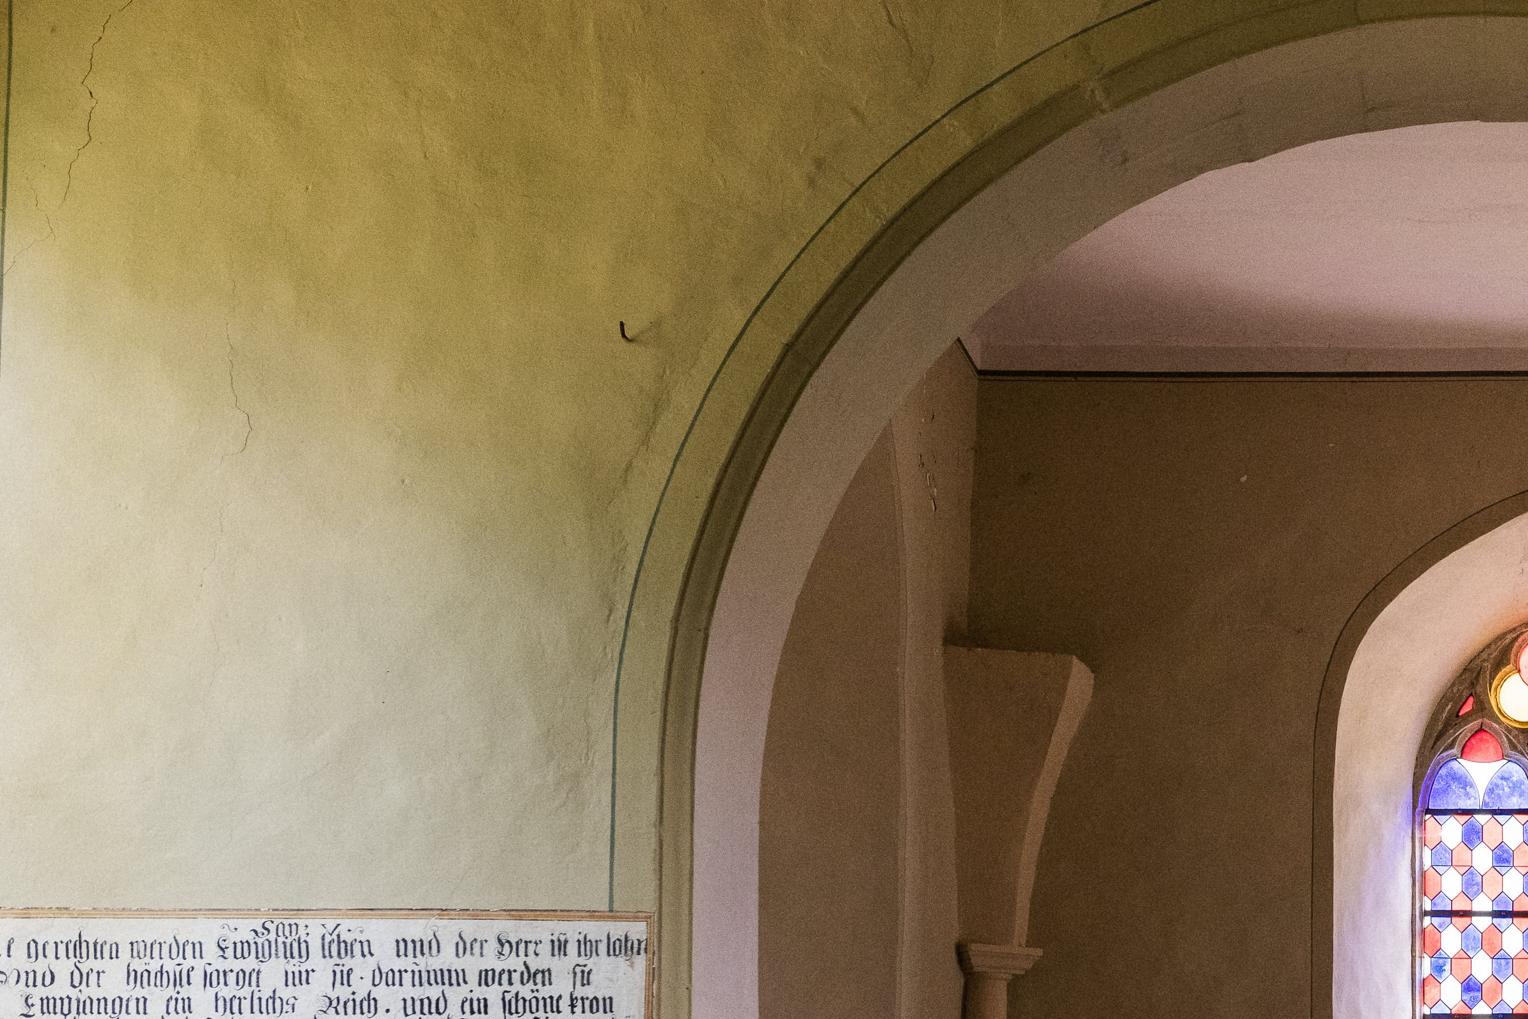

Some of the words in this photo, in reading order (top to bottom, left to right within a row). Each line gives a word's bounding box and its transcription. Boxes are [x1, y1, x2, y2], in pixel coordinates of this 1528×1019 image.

[26, 930, 120, 963] gerechten
[129, 934, 204, 960] werden
[217, 932, 310, 963] Ewiglich
[321, 932, 375, 959] leben
[395, 930, 441, 959] und
[455, 930, 488, 959] der
[495, 932, 544, 961] Herr
[550, 932, 569, 960] ist
[576, 931, 602, 960] ihr
[69, 961, 106, 988] der
[477, 961, 553, 987] werden
[572, 963, 593, 990] sie
[165, 991, 193, 1015] ein
[402, 989, 448, 1017] und
[460, 989, 489, 1015] ein
[501, 990, 563, 1019] schöne
